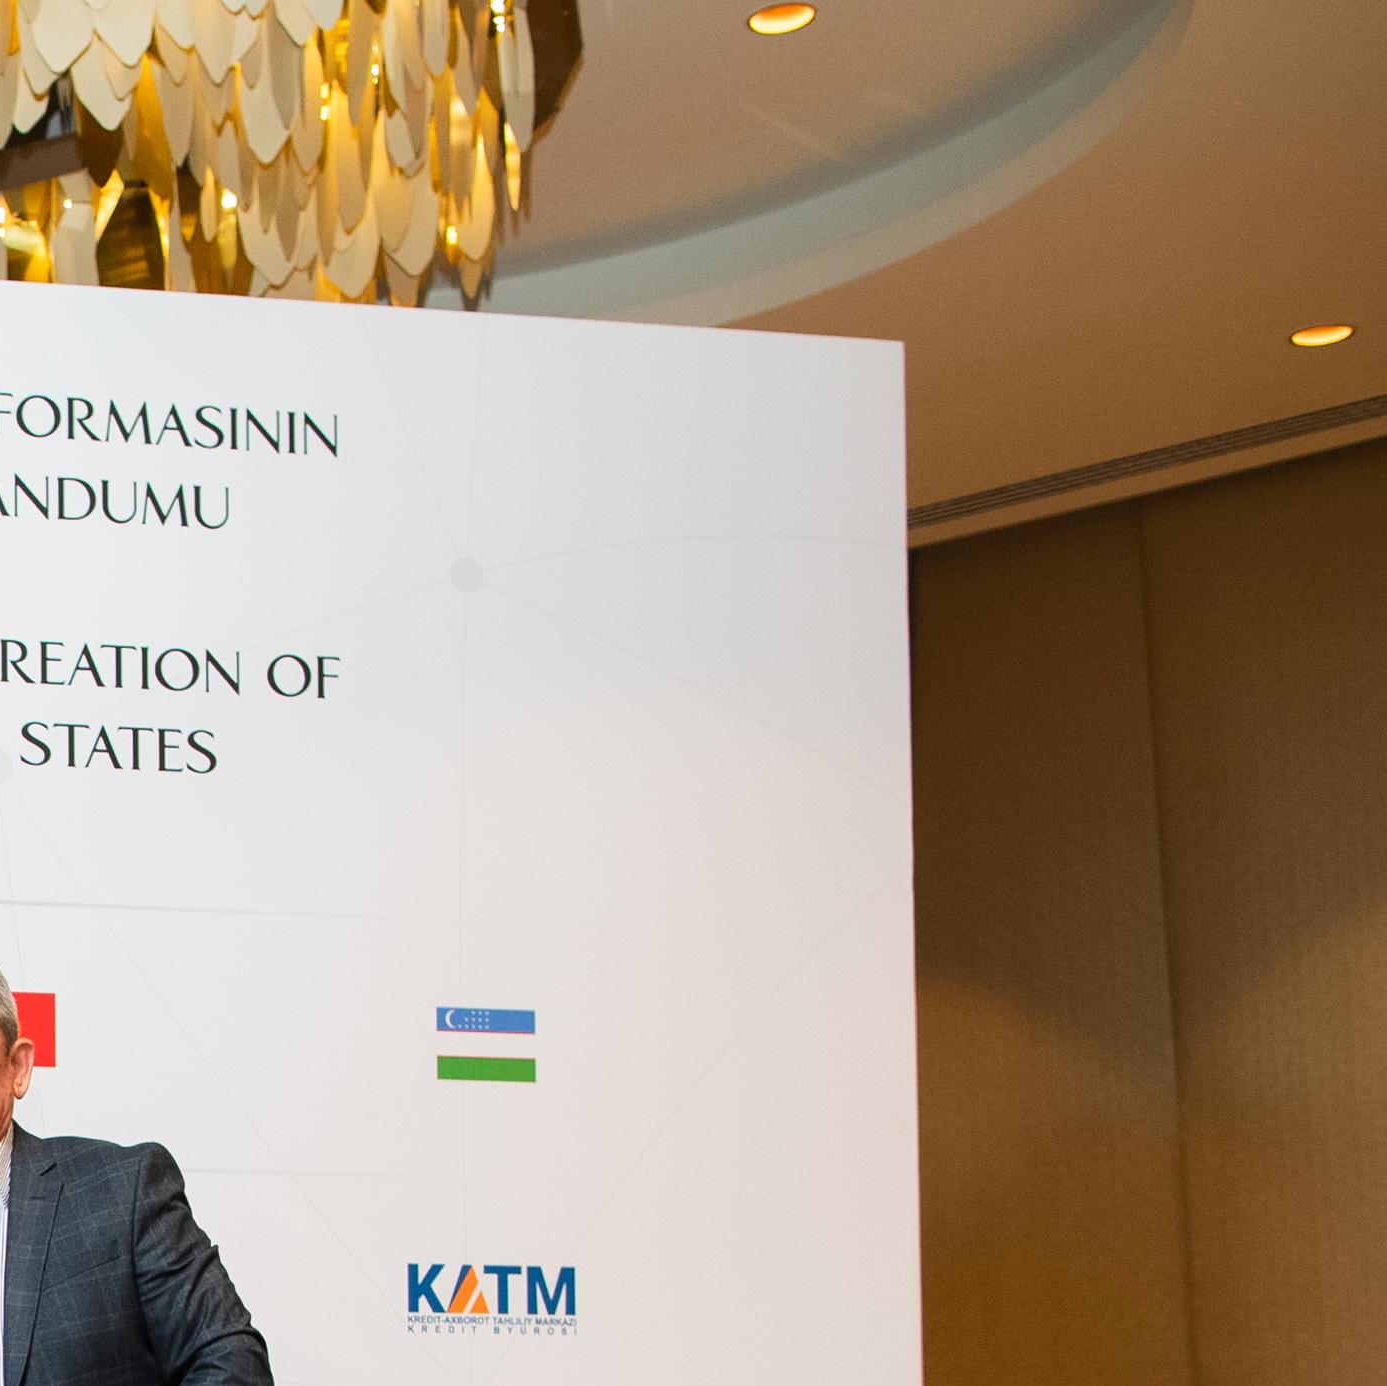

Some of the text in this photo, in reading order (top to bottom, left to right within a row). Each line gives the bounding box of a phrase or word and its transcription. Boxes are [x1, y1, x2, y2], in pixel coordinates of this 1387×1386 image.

[267, 654, 341, 699] OF
[19, 721, 217, 774] STATES
[407, 1263, 576, 1316] KATM
[535, 1317, 577, 1327] MARKAZI
